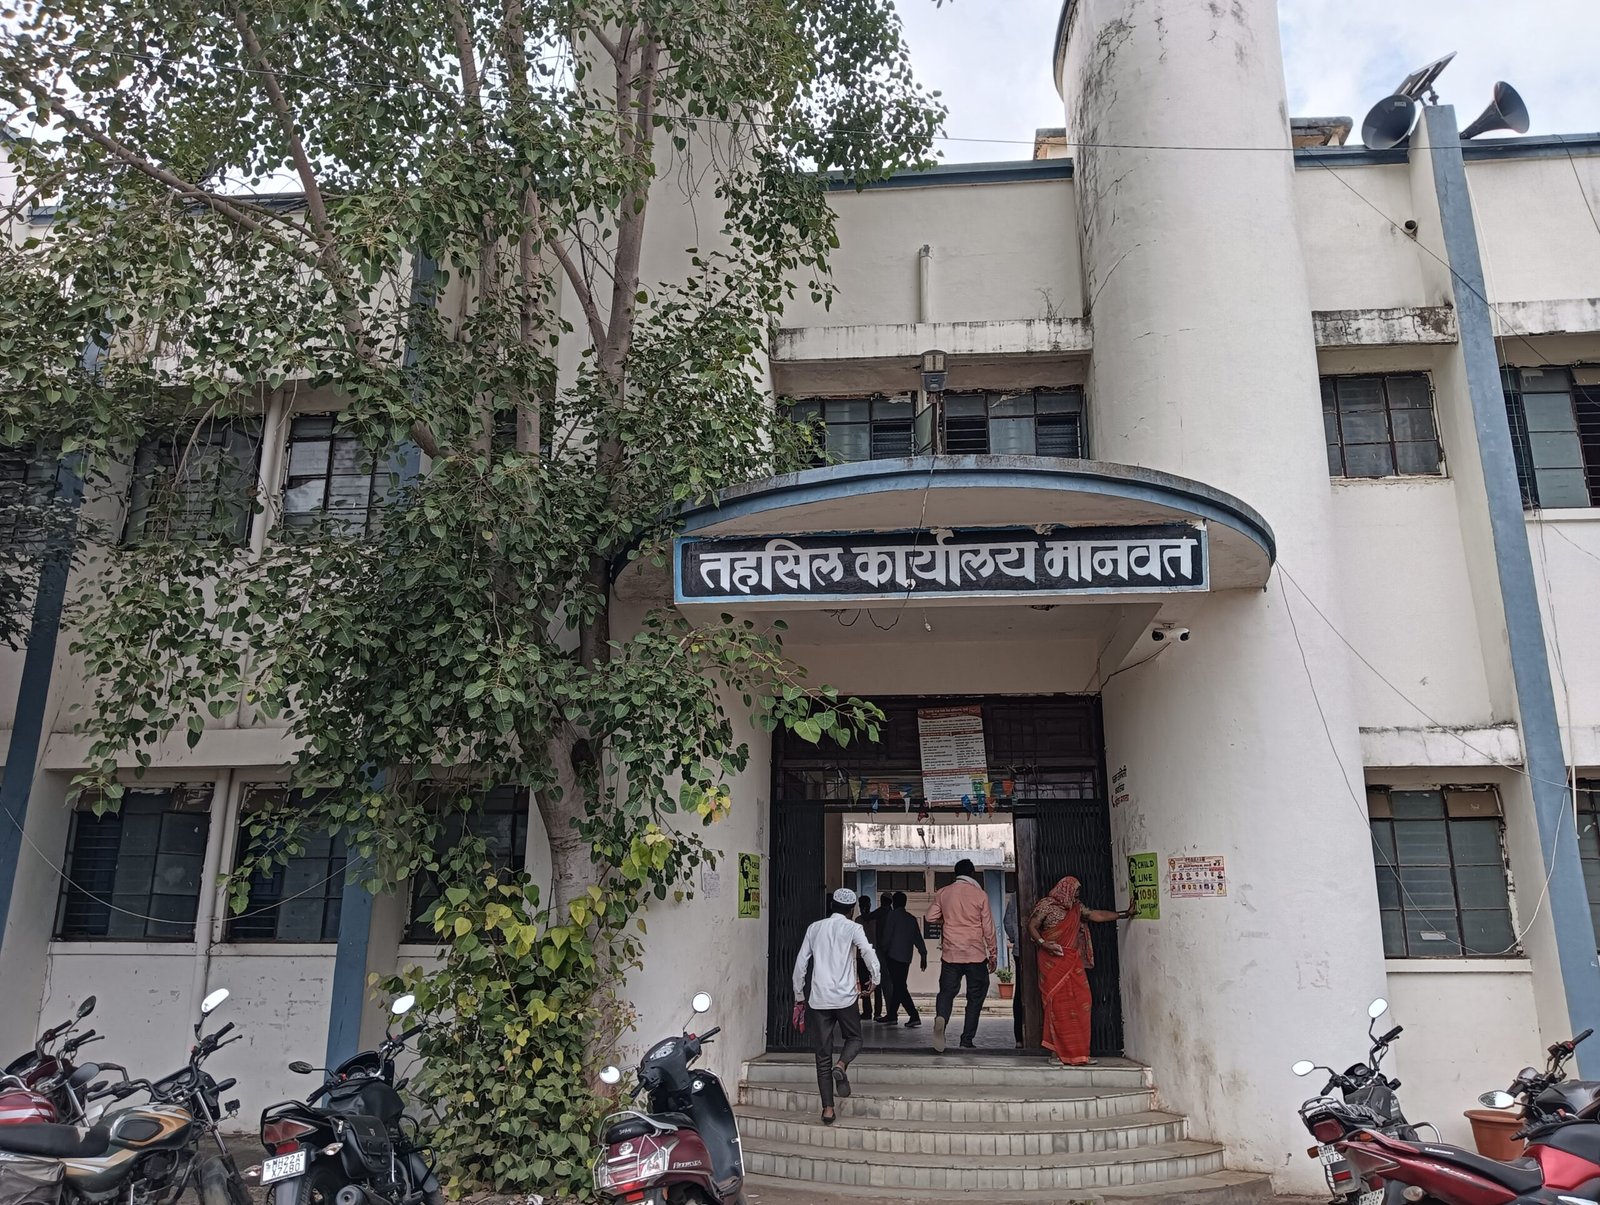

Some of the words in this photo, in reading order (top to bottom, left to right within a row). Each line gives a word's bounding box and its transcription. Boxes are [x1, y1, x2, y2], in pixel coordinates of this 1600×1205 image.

[700, 540, 844, 594] तहसिल
[850, 531, 1039, 588] कार्यालय
[1045, 537, 1197, 582] मानवत
[1137, 861, 1154, 869] CHILD
[1138, 874, 1152, 882] LINE
[1139, 889, 1157, 900] 1098
